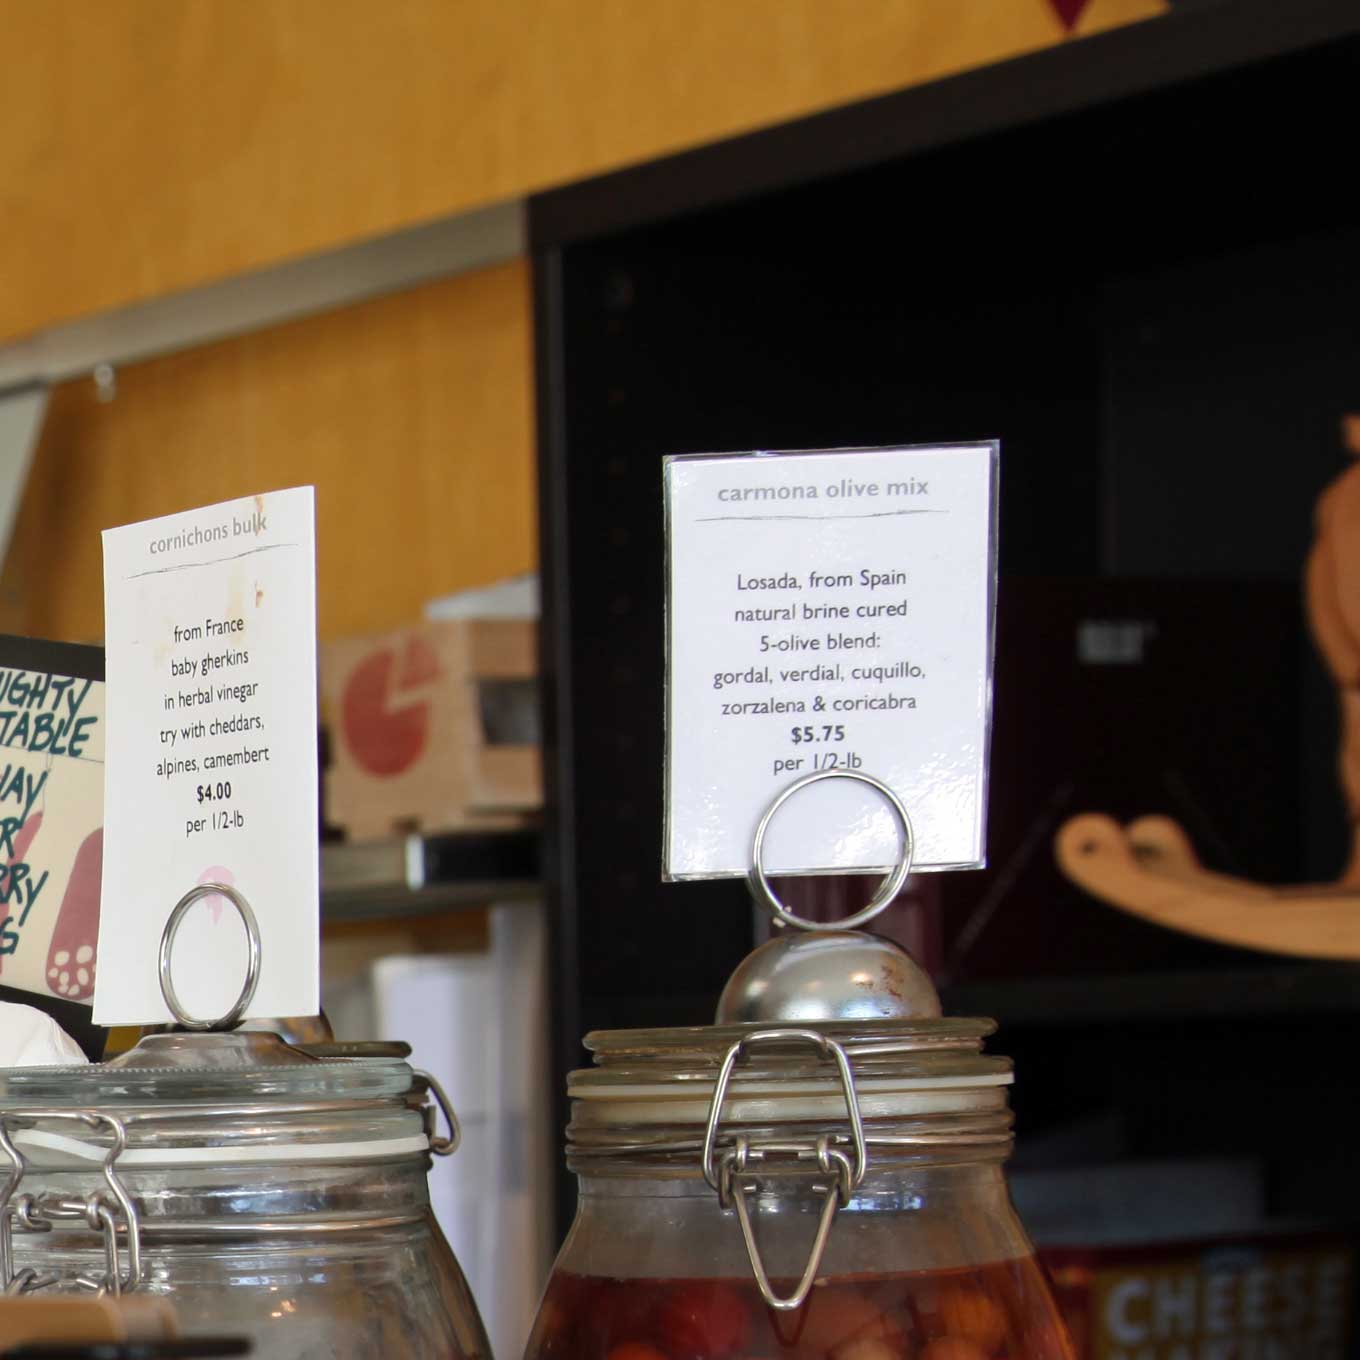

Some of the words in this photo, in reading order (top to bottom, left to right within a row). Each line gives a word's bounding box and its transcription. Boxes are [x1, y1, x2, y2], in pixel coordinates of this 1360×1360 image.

[718, 484, 818, 502] carmona
[826, 479, 879, 499] olive
[886, 478, 929, 496] mix
[150, 522, 228, 555] cornichons
[233, 512, 267, 537] bulk
[737, 572, 802, 591] Losada,
[809, 571, 853, 588] from
[860, 570, 906, 590] Spain
[734, 604, 796, 623] natural
[803, 602, 850, 620] brine
[856, 600, 907, 617] cured
[174, 625, 202, 643] from
[206, 617, 244, 638] France
[760, 634, 820, 652] 5-olive
[827, 631, 880, 650] blend:
[171, 657, 198, 678] baby
[201, 649, 249, 675] gherkins
[713, 667, 773, 689] gordal,
[780, 663, 844, 683] verdial,
[851, 661, 925, 682] cuquillo,
[165, 694, 175, 711] in
[179, 685, 214, 708] herbal
[217, 680, 259, 703] vinegar
[721, 697, 806, 716] zorzalena
[813, 696, 826, 711] &
[833, 693, 917, 711] coricabra
[160, 728, 178, 747] try
[181, 717, 206, 739] with
[210, 714, 265, 737] cheddars,
[791, 725, 845, 745] $5.75
[156, 757, 200, 778] alpines,
[203, 746, 270, 770] camembert
[773, 757, 804, 775] per
[813, 753, 862, 770] 1/2-lb
[197, 781, 232, 804] $4.00
[186, 817, 208, 838] per
[212, 809, 244, 830] 1/2-lb
[1107, 1260, 1345, 1345] CHEESE
